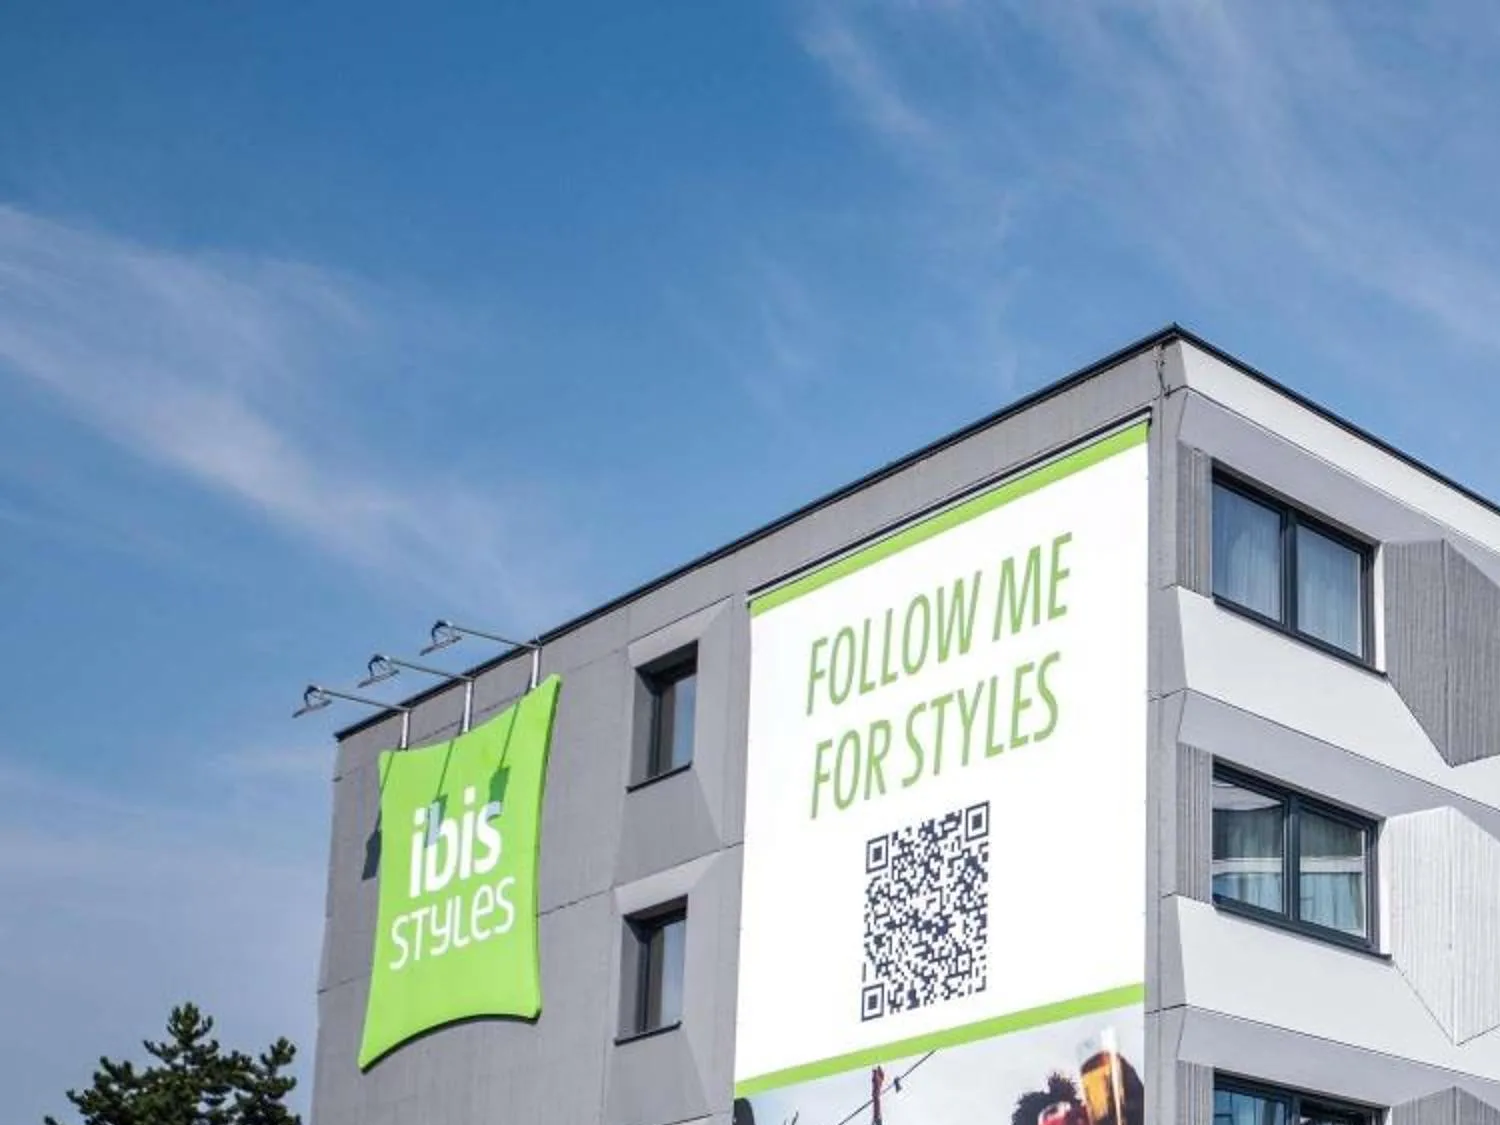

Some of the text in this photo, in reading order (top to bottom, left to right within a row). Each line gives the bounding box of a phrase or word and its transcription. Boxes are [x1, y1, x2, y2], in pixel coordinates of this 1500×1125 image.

[807, 532, 1073, 716] FOLLOW ME
[811, 650, 1061, 819] FOR STYLES
[409, 785, 504, 898] ibis
